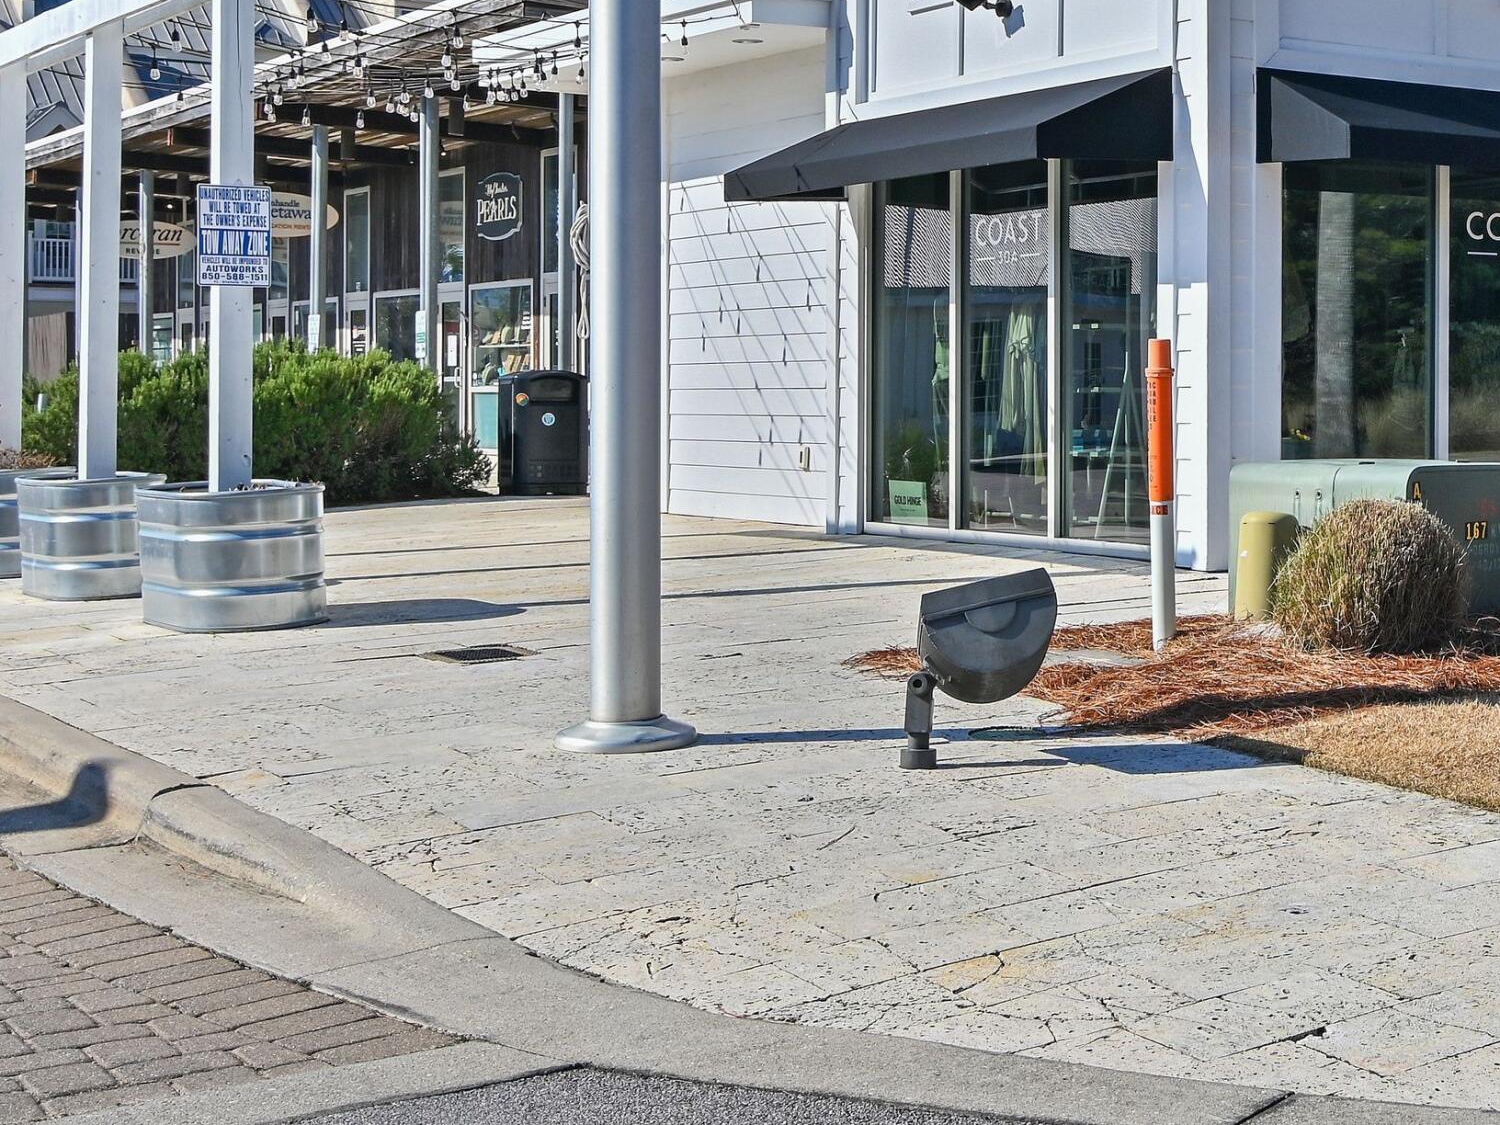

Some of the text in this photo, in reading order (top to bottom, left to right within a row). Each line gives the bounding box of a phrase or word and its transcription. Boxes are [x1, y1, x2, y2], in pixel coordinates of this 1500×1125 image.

[200, 188, 269, 202] UNAUTHORIZED VEHICLES
[209, 201, 261, 215] WILL BE TOWED AT
[271, 207, 312, 220] etawa
[476, 195, 517, 226] PEARLS
[203, 213, 267, 228] THE OWNER'S EXPENSE
[976, 213, 1041, 246] COAST
[201, 229, 268, 256] TOW AWAY ZONE
[999, 250, 1018, 265] 30A
[202, 272, 268, 282] 850-588-1511
[206, 265, 264, 274] AUTOWORKS
[1413, 482, 1421, 499] A
[1466, 521, 1488, 541] 167
